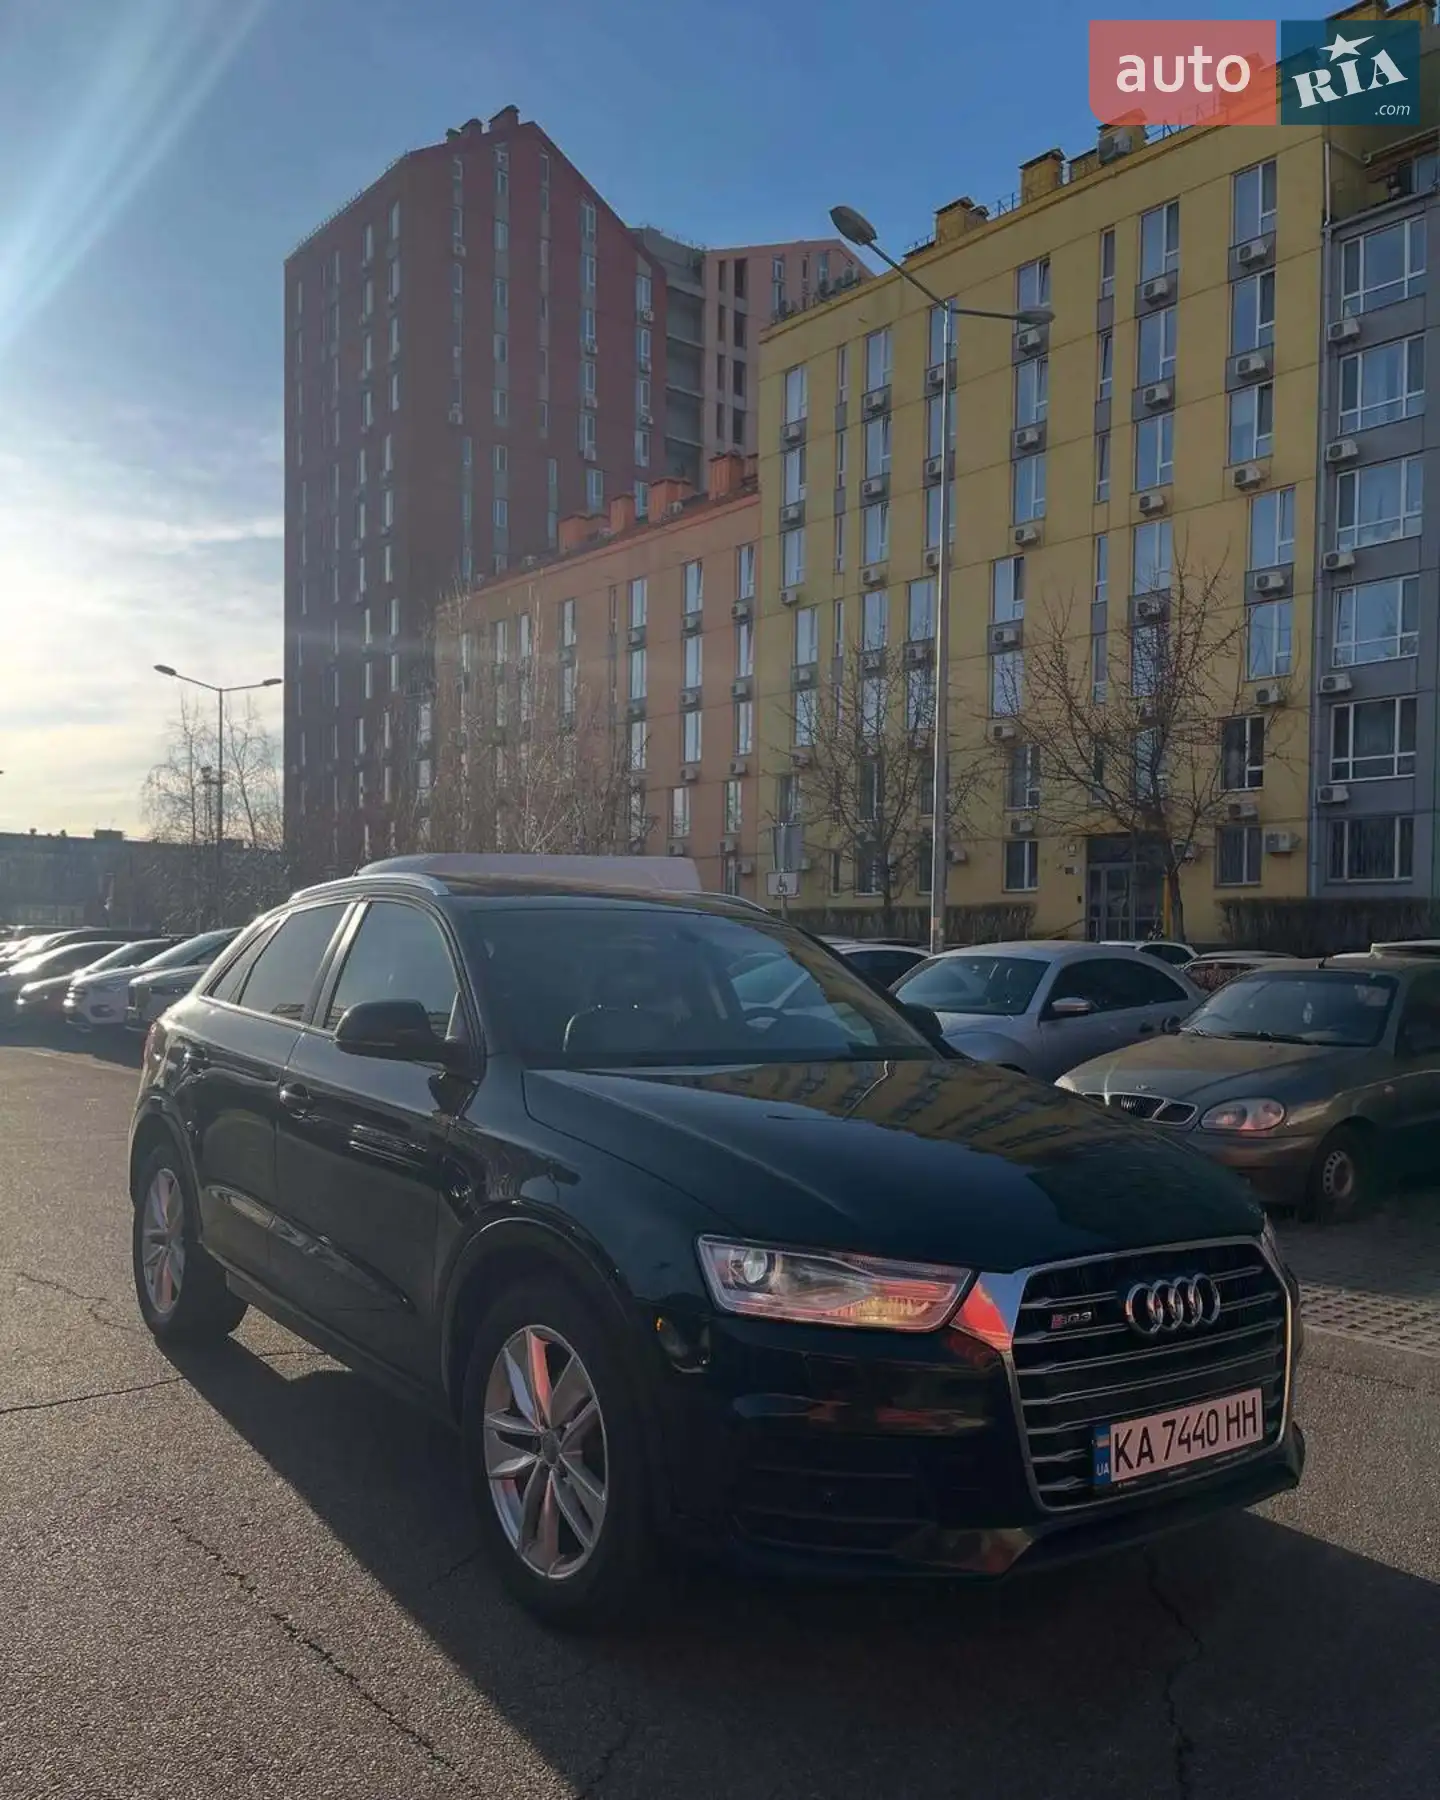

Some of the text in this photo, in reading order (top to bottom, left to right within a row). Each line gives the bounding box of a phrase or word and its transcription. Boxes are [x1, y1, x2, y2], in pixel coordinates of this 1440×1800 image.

[1114, 1397, 1257, 1472] KA 7440 HH
[1096, 1462, 1110, 1476] UA
